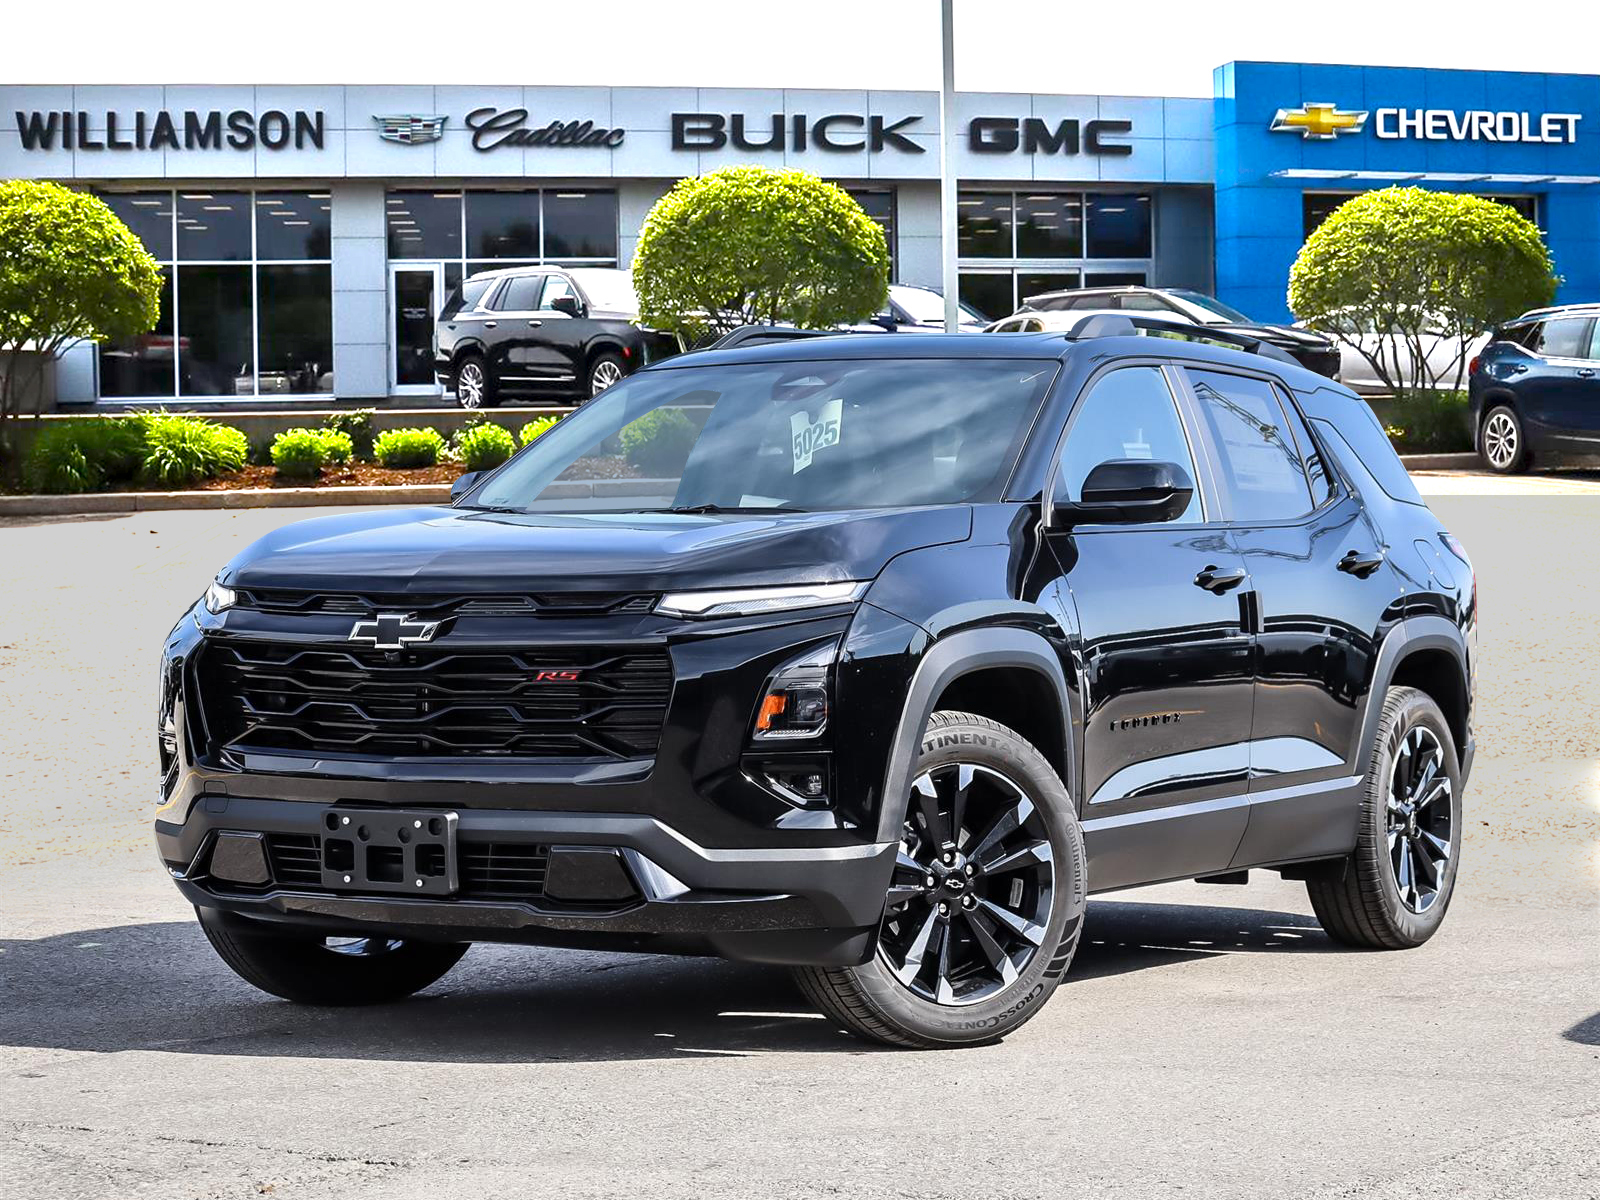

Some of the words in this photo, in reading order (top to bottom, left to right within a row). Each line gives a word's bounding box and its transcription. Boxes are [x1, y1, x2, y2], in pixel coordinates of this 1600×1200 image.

[15, 110, 325, 151] WILLIAMSON
[465, 107, 625, 153] Cadillac
[671, 112, 926, 154] BUICK
[968, 116, 1134, 156] GMC
[1374, 107, 1583, 144] CHEVROLET
[794, 419, 838, 460] 5025
[535, 671, 578, 681] RS
